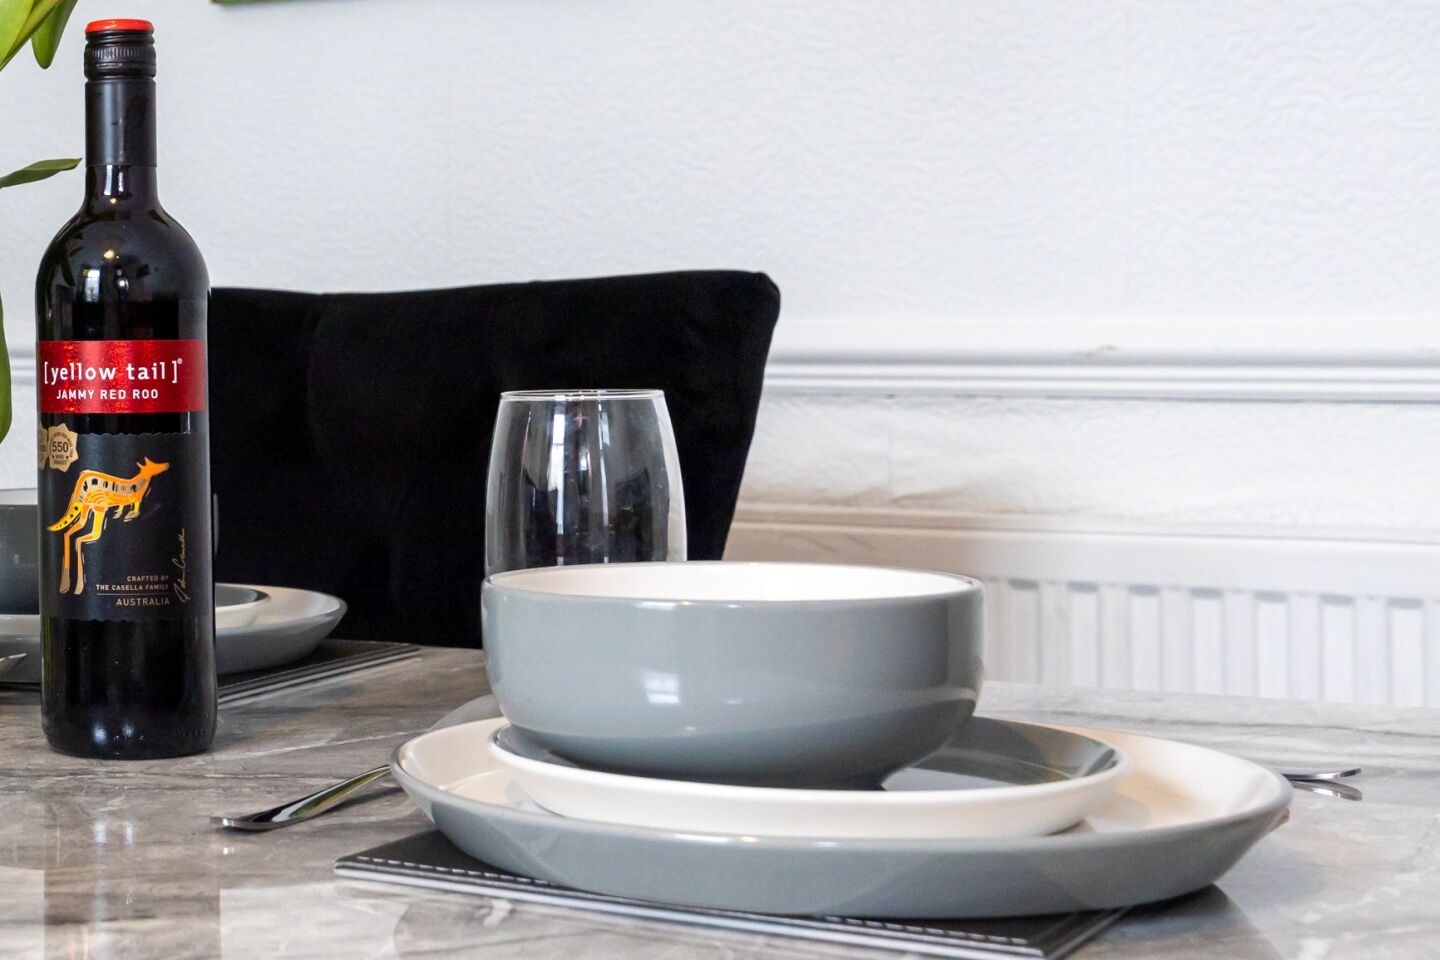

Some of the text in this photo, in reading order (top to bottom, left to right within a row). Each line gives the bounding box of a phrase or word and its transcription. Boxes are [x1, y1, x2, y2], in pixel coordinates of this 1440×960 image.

[56, 389, 158, 400] JAMMY RED ROO
[51, 441, 69, 453] 550
[116, 598, 170, 606] AUSTRALIA
